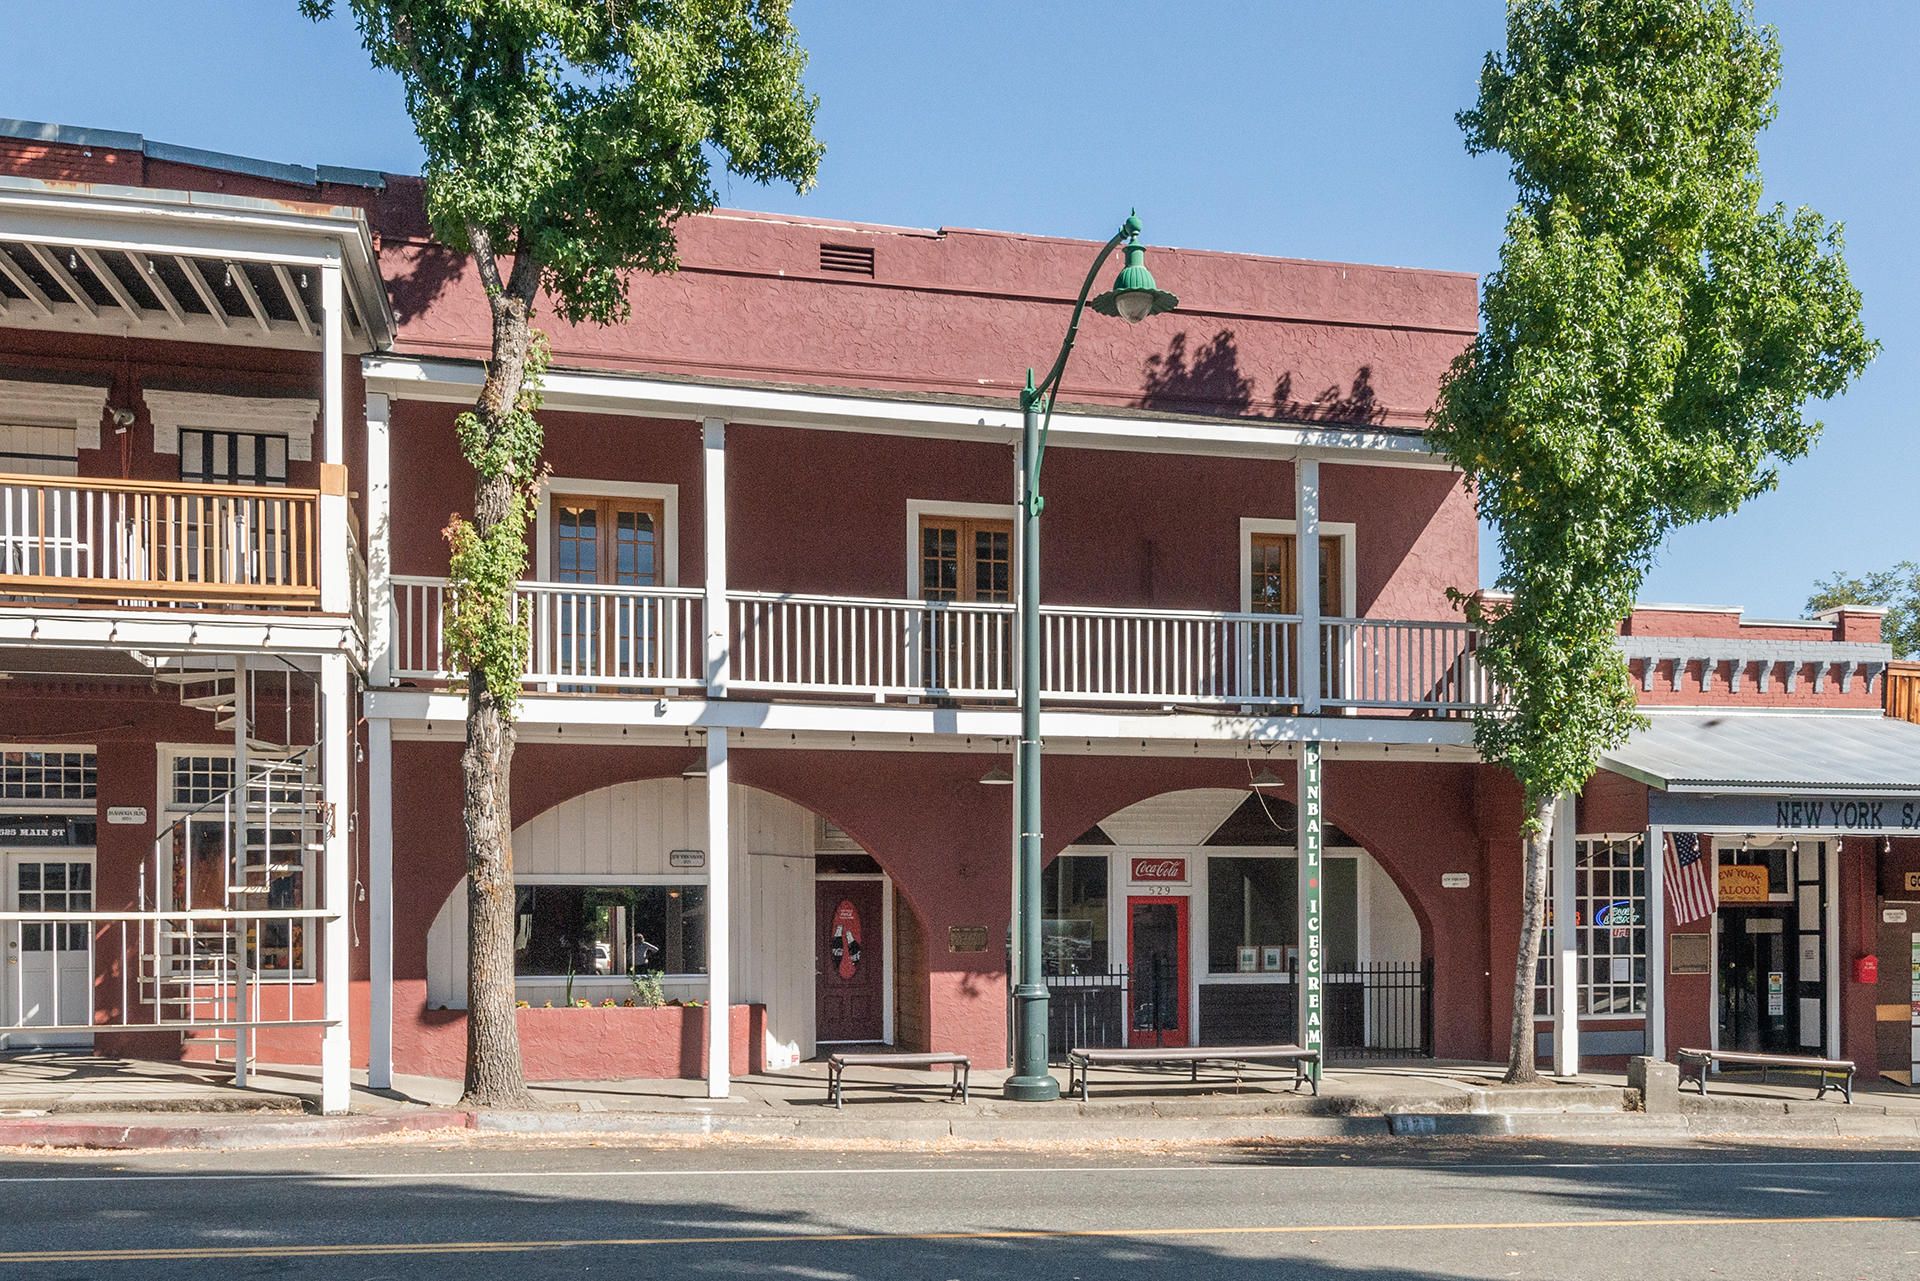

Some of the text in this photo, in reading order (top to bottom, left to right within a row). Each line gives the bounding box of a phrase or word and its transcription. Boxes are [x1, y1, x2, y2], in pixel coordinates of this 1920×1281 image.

[1307, 752, 1319, 866] PINBALL
[1777, 801, 1823, 828] NEW
[1830, 801, 1883, 829] YORK
[1719, 868, 1761, 885] EW YORK
[1149, 886, 1171, 895] 529
[1719, 885, 1760, 895] ALOON
[1603, 914, 1639, 924] LGHT
